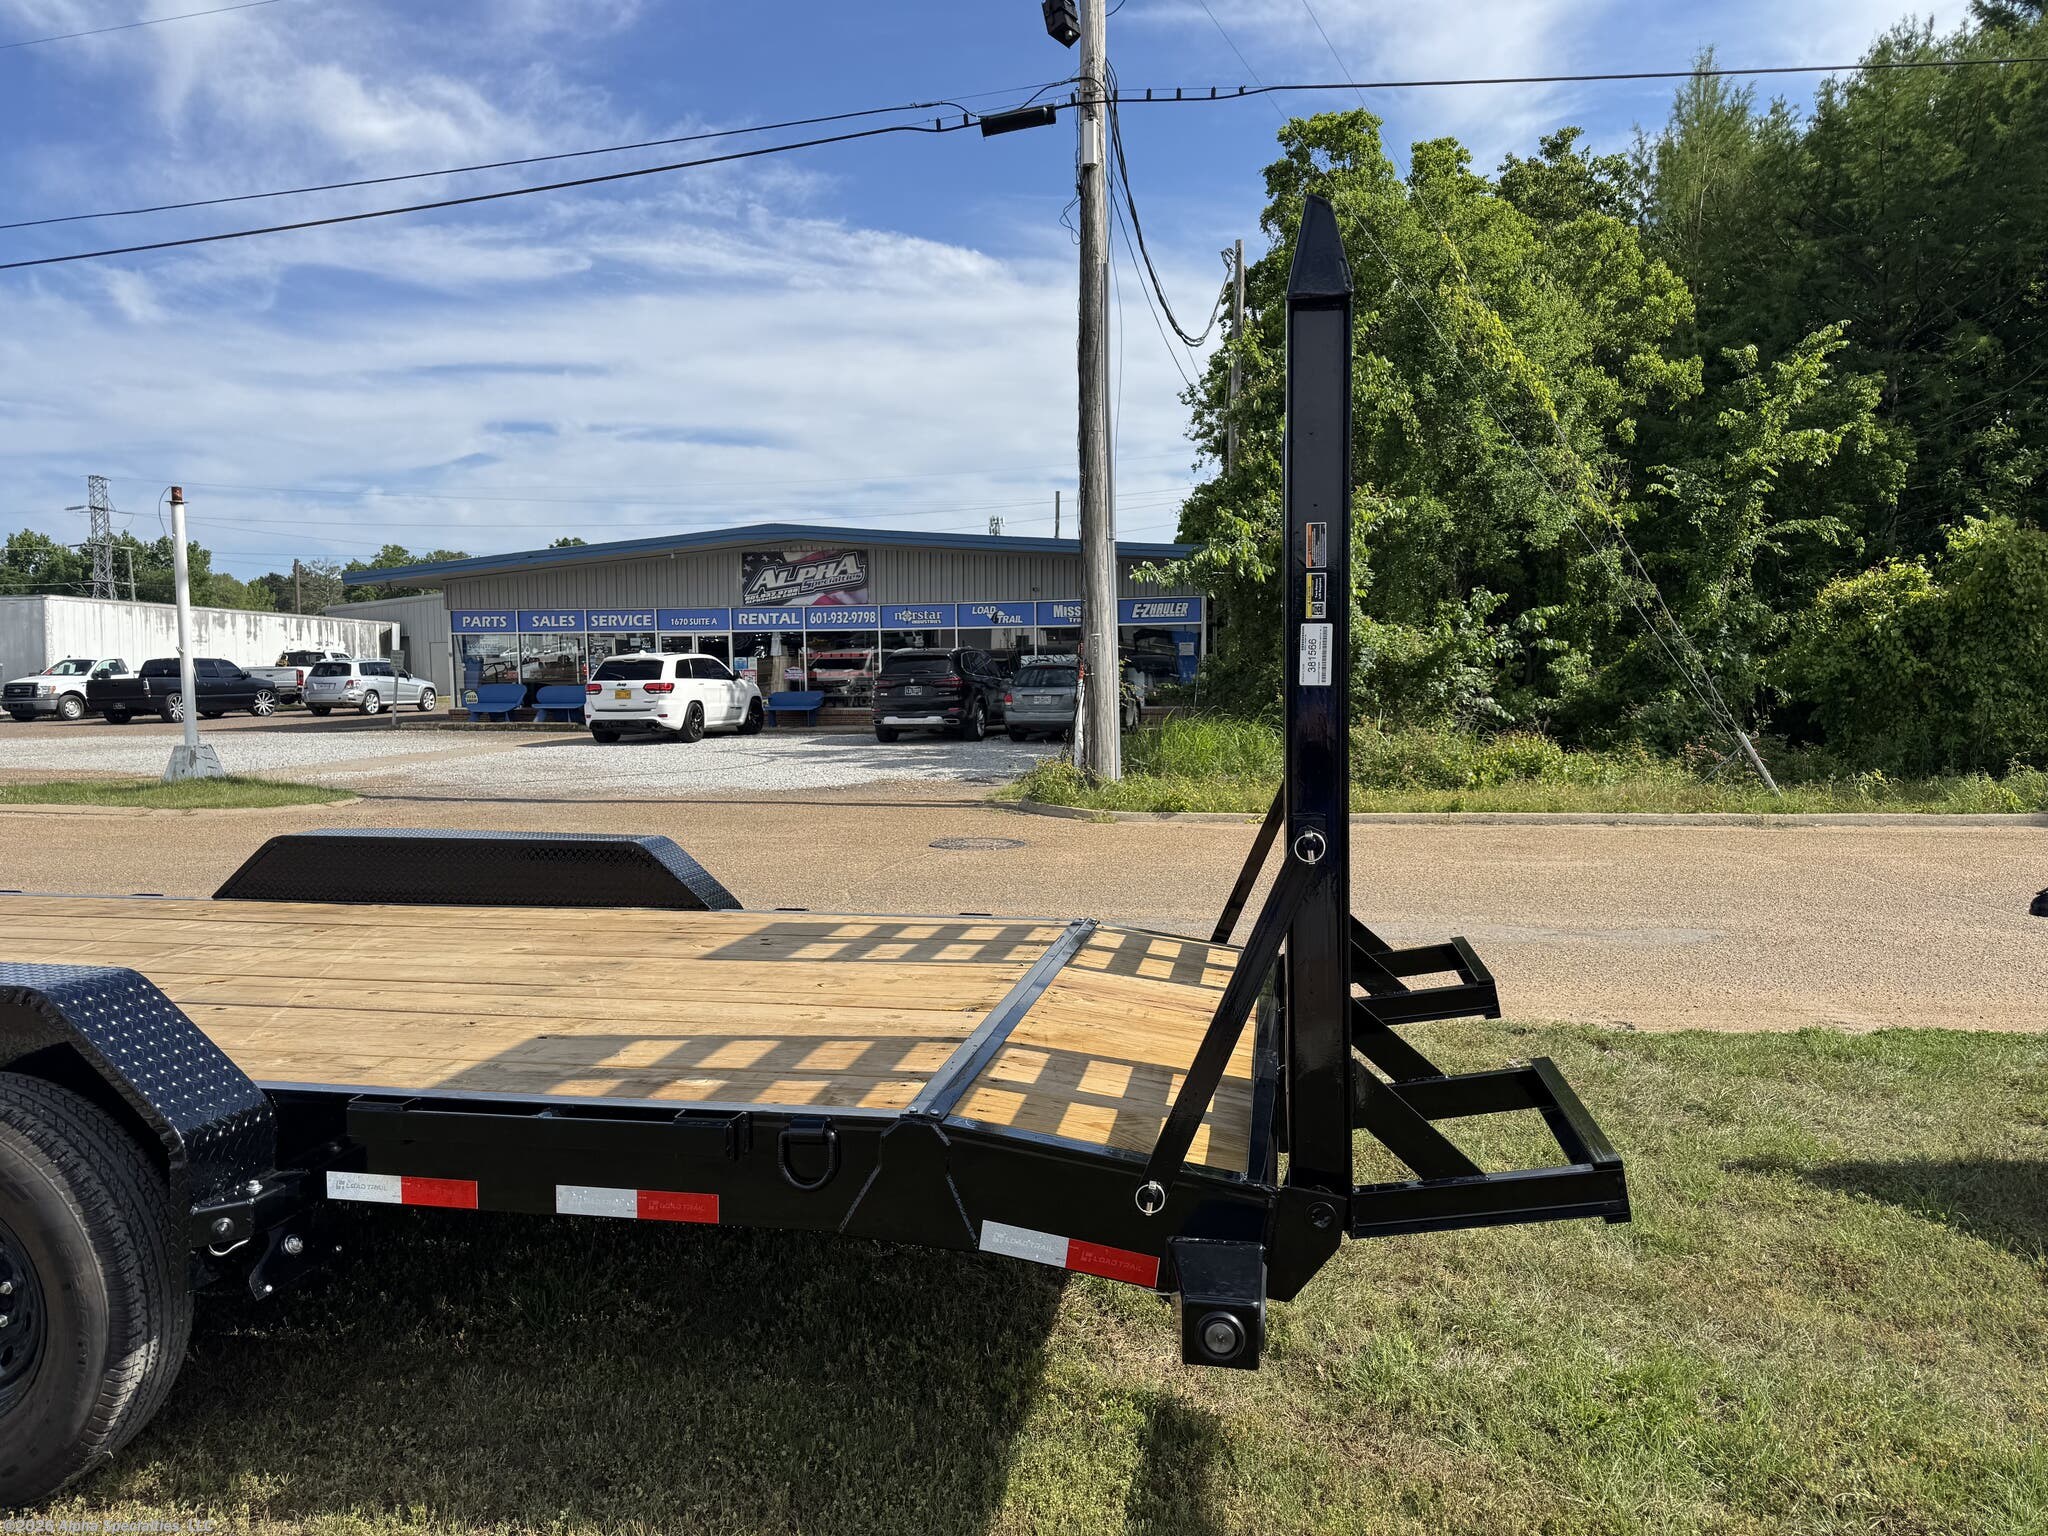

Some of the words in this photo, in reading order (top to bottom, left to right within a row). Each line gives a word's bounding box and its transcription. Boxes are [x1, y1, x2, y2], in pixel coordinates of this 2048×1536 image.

[750, 554, 861, 592] ALPHA
[532, 615, 576, 627] SALES
[591, 614, 652, 627] SERVICE
[738, 613, 800, 625] RENTAL
[810, 611, 876, 624] 601-932-9798
[972, 606, 996, 615] LOAD
[997, 615, 1023, 624] TRAIL
[462, 616, 507, 628] PARTS
[671, 618, 688, 626] 1670
[689, 618, 710, 626] SUITE
[1307, 638, 1317, 673] 381566
